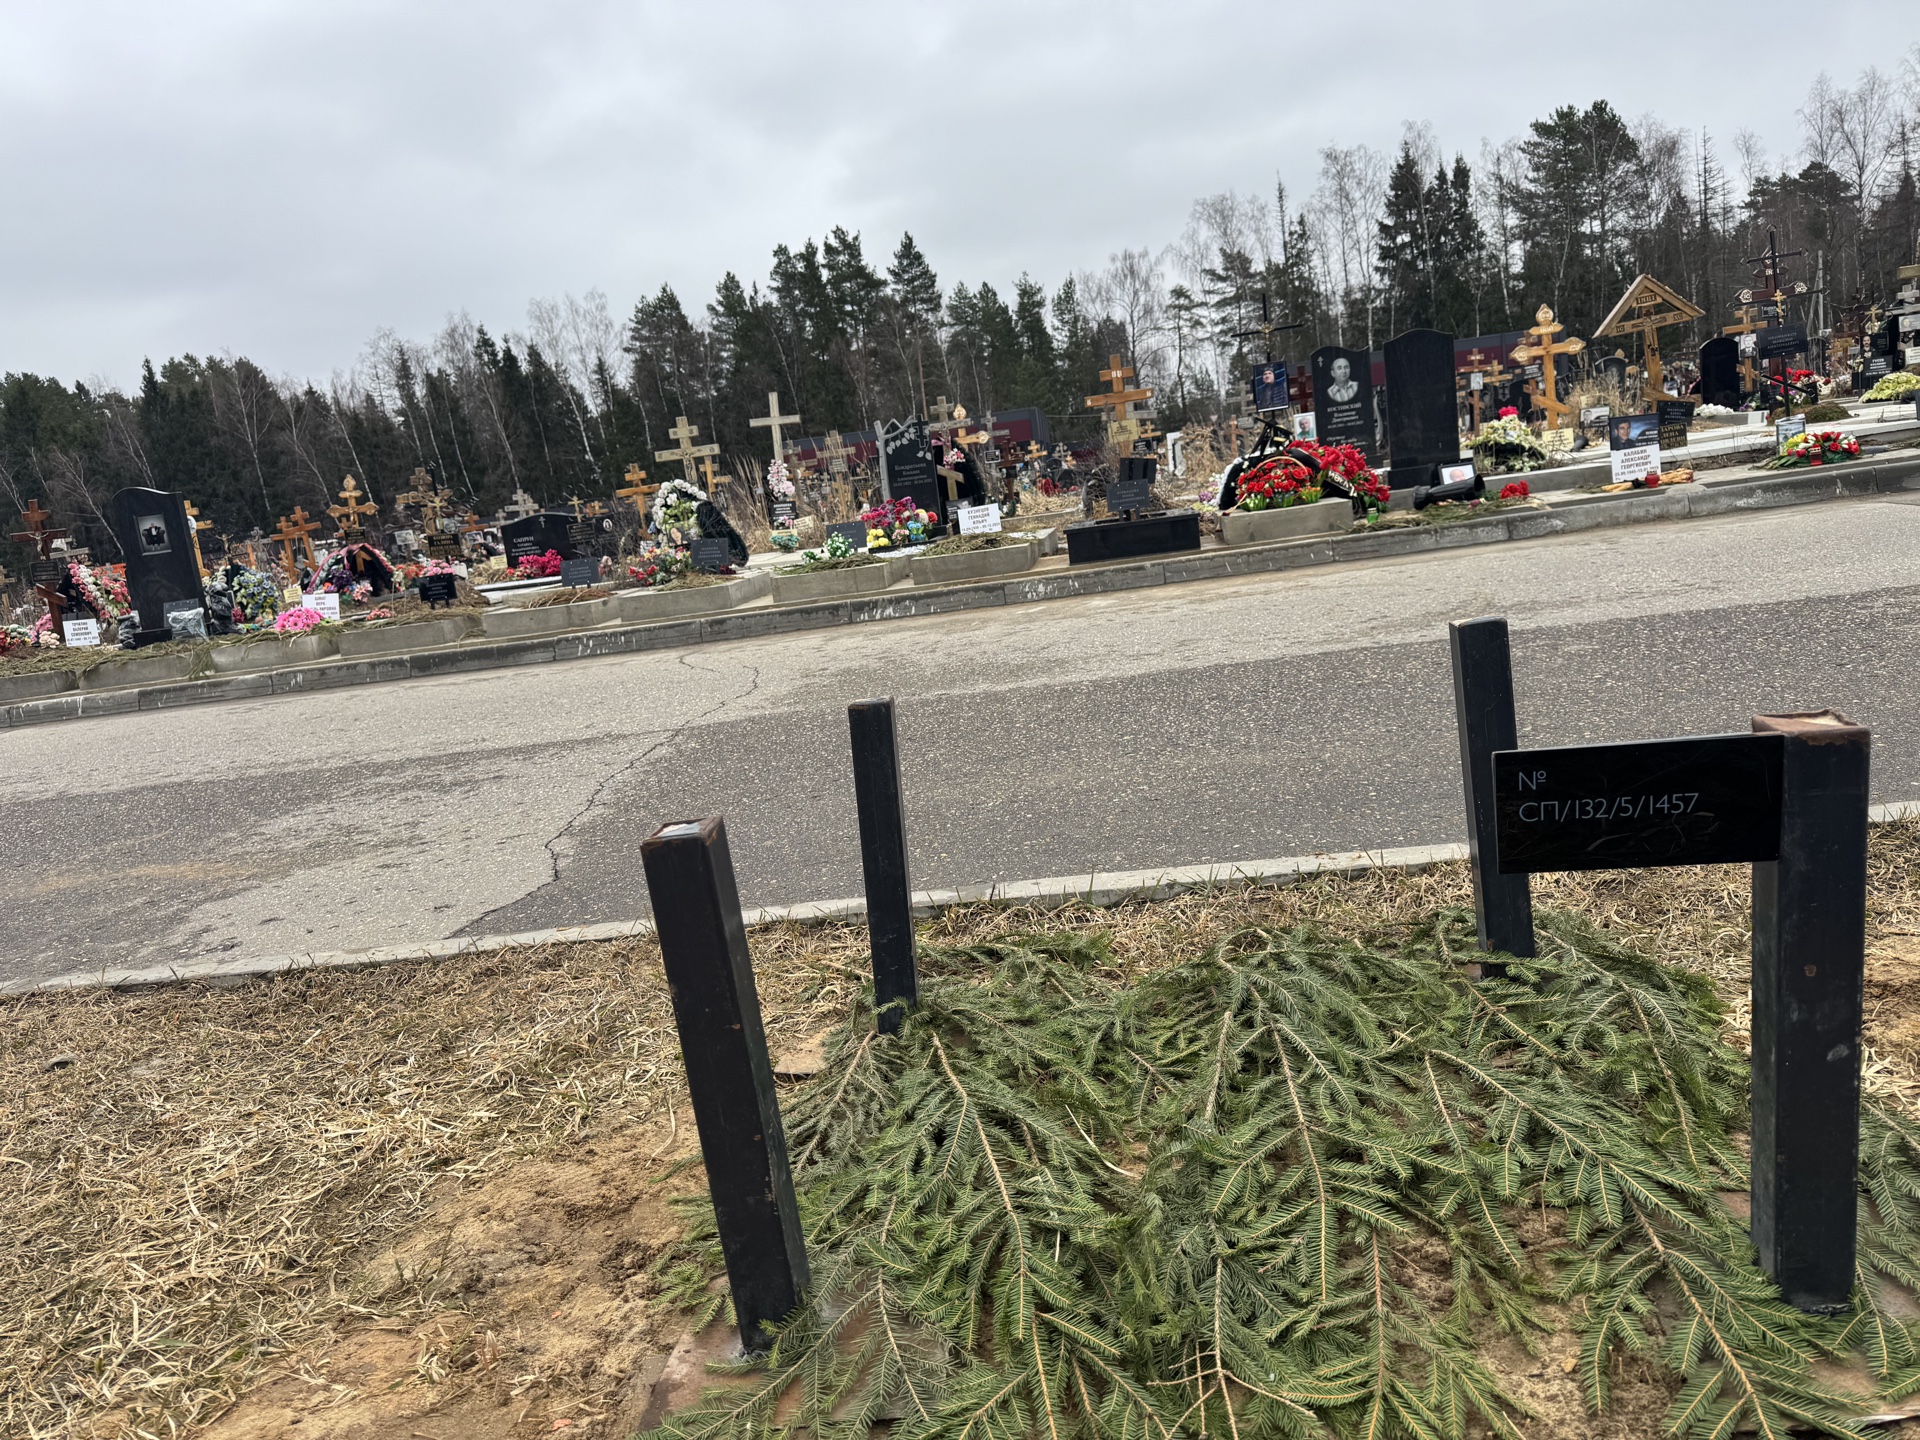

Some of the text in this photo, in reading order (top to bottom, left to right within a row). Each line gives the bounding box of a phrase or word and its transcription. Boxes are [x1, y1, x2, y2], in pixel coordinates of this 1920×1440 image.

[1623, 449, 1647, 457] КАЛАБИН
[1620, 454, 1651, 464] АЛЕКСАНДР
[1620, 460, 1652, 470] ГЕОРГИЕВИЧ
[967, 507, 989, 515] КУЗНЕЦОВ
[968, 513, 990, 521] ГЕННАДИЙ
[1518, 770, 1547, 791] №
[1518, 792, 1700, 823] СП/132/5/1457
